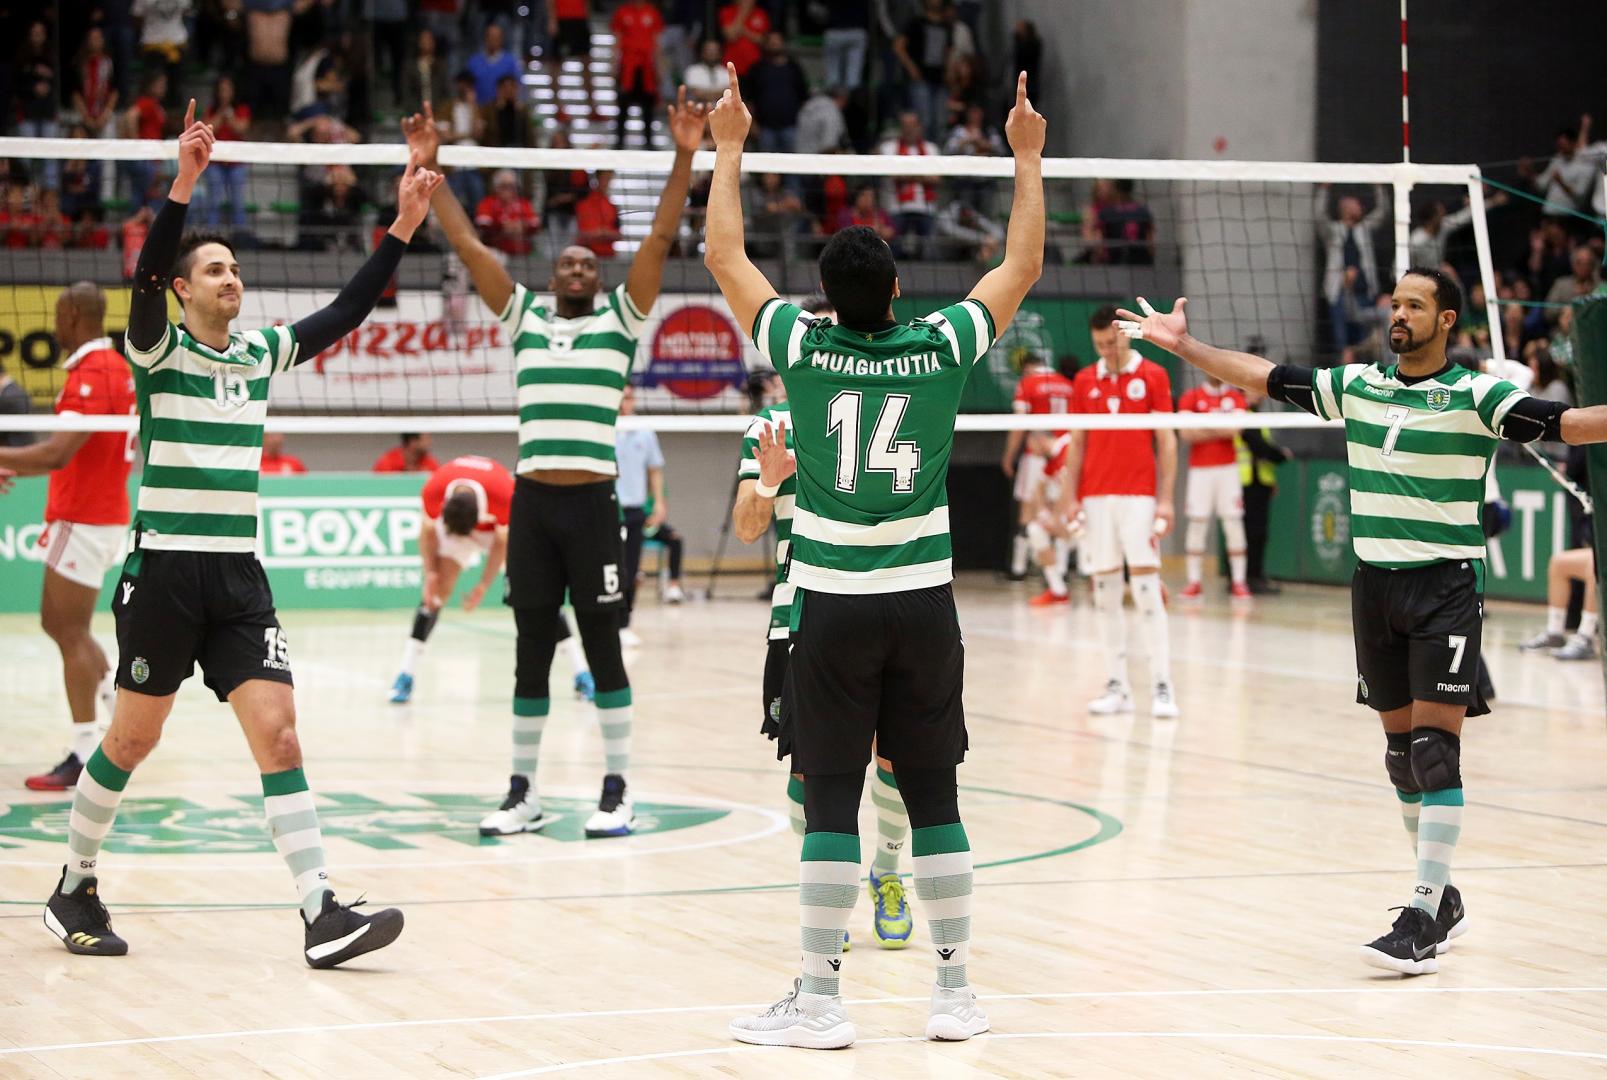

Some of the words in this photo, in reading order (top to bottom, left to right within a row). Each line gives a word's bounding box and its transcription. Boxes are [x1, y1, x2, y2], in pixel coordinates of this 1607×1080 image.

[811, 349, 942, 376] MUAGUTUTIA
[209, 363, 251, 408] 15
[1363, 385, 1395, 398] macron
[825, 389, 921, 494] 14
[1381, 404, 1411, 456] 7
[603, 563, 619, 594] 5
[264, 627, 288, 662] 15
[1448, 635, 1467, 674] 7
[1437, 682, 1470, 693] macron
